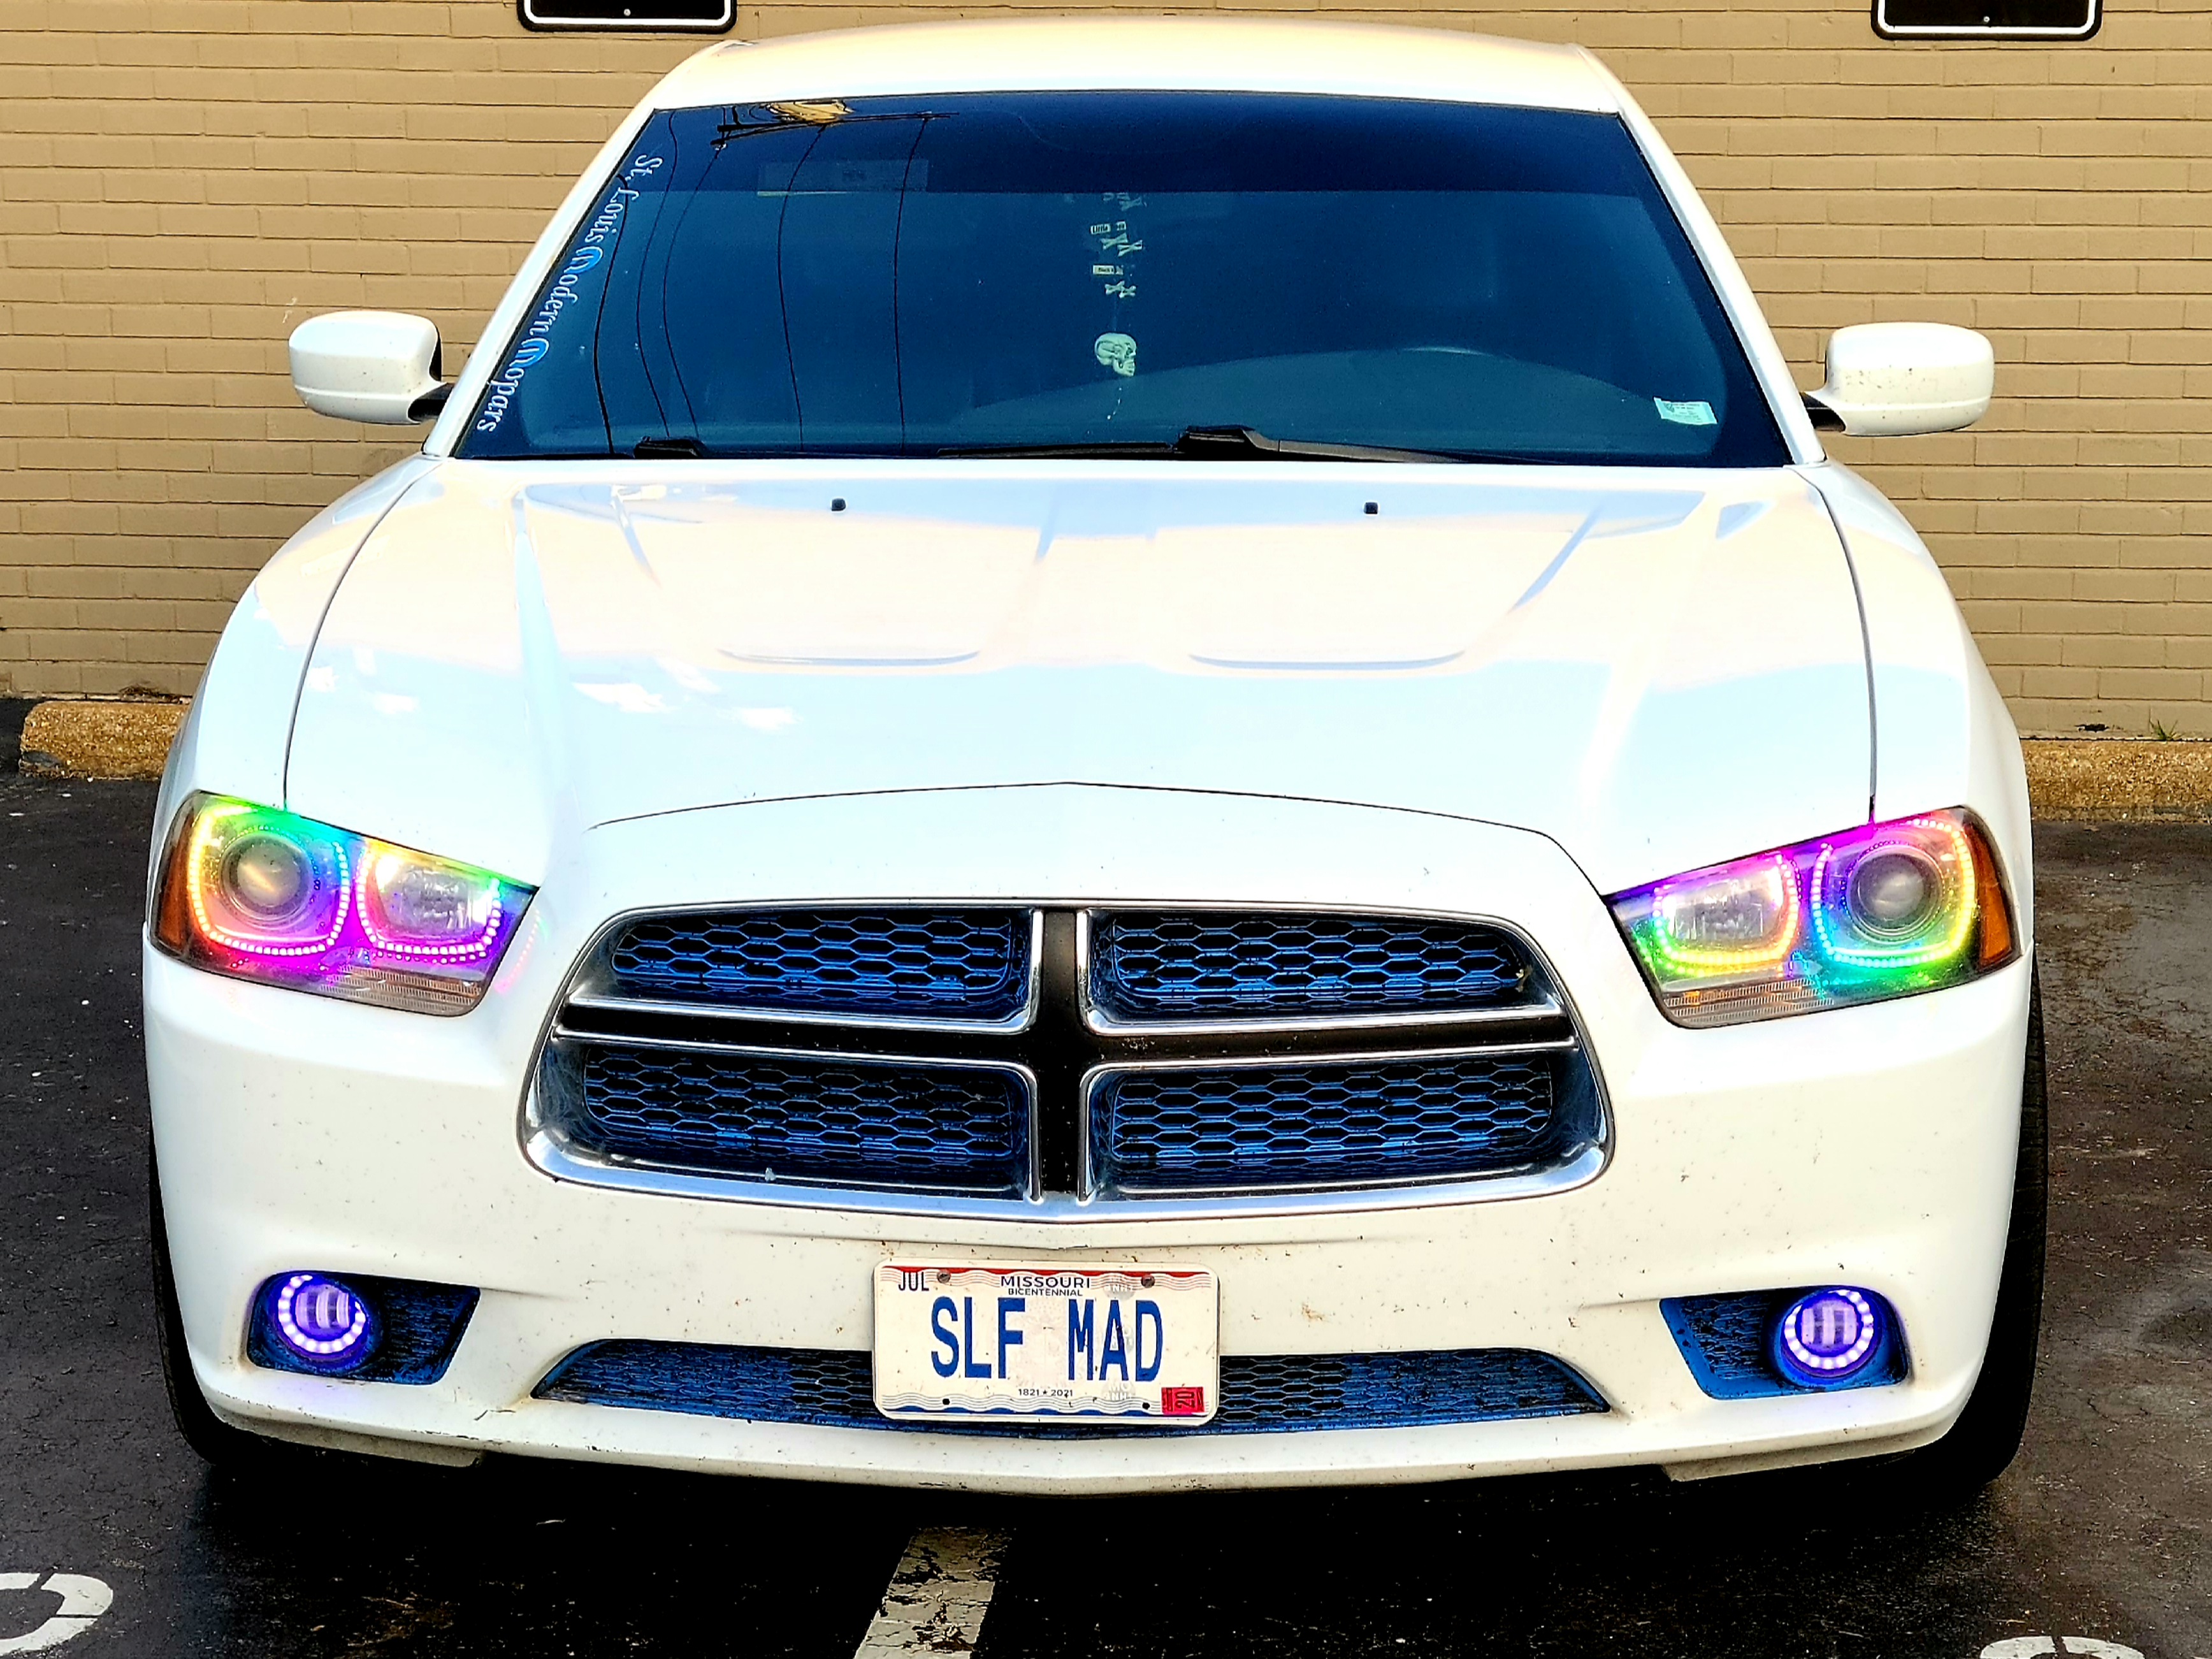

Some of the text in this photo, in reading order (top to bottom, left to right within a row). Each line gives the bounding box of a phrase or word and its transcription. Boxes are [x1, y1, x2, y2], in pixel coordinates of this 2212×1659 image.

[476, 154, 663, 432] St. Louis Modern Mopars
[898, 1271, 930, 1292] JUL
[1001, 1275, 1090, 1289] MISSOURI
[1008, 1287, 1084, 1297] BICENTENNIAL
[930, 1296, 1163, 1382] SLF MAD
[1018, 1388, 1073, 1397] 1821 2021
